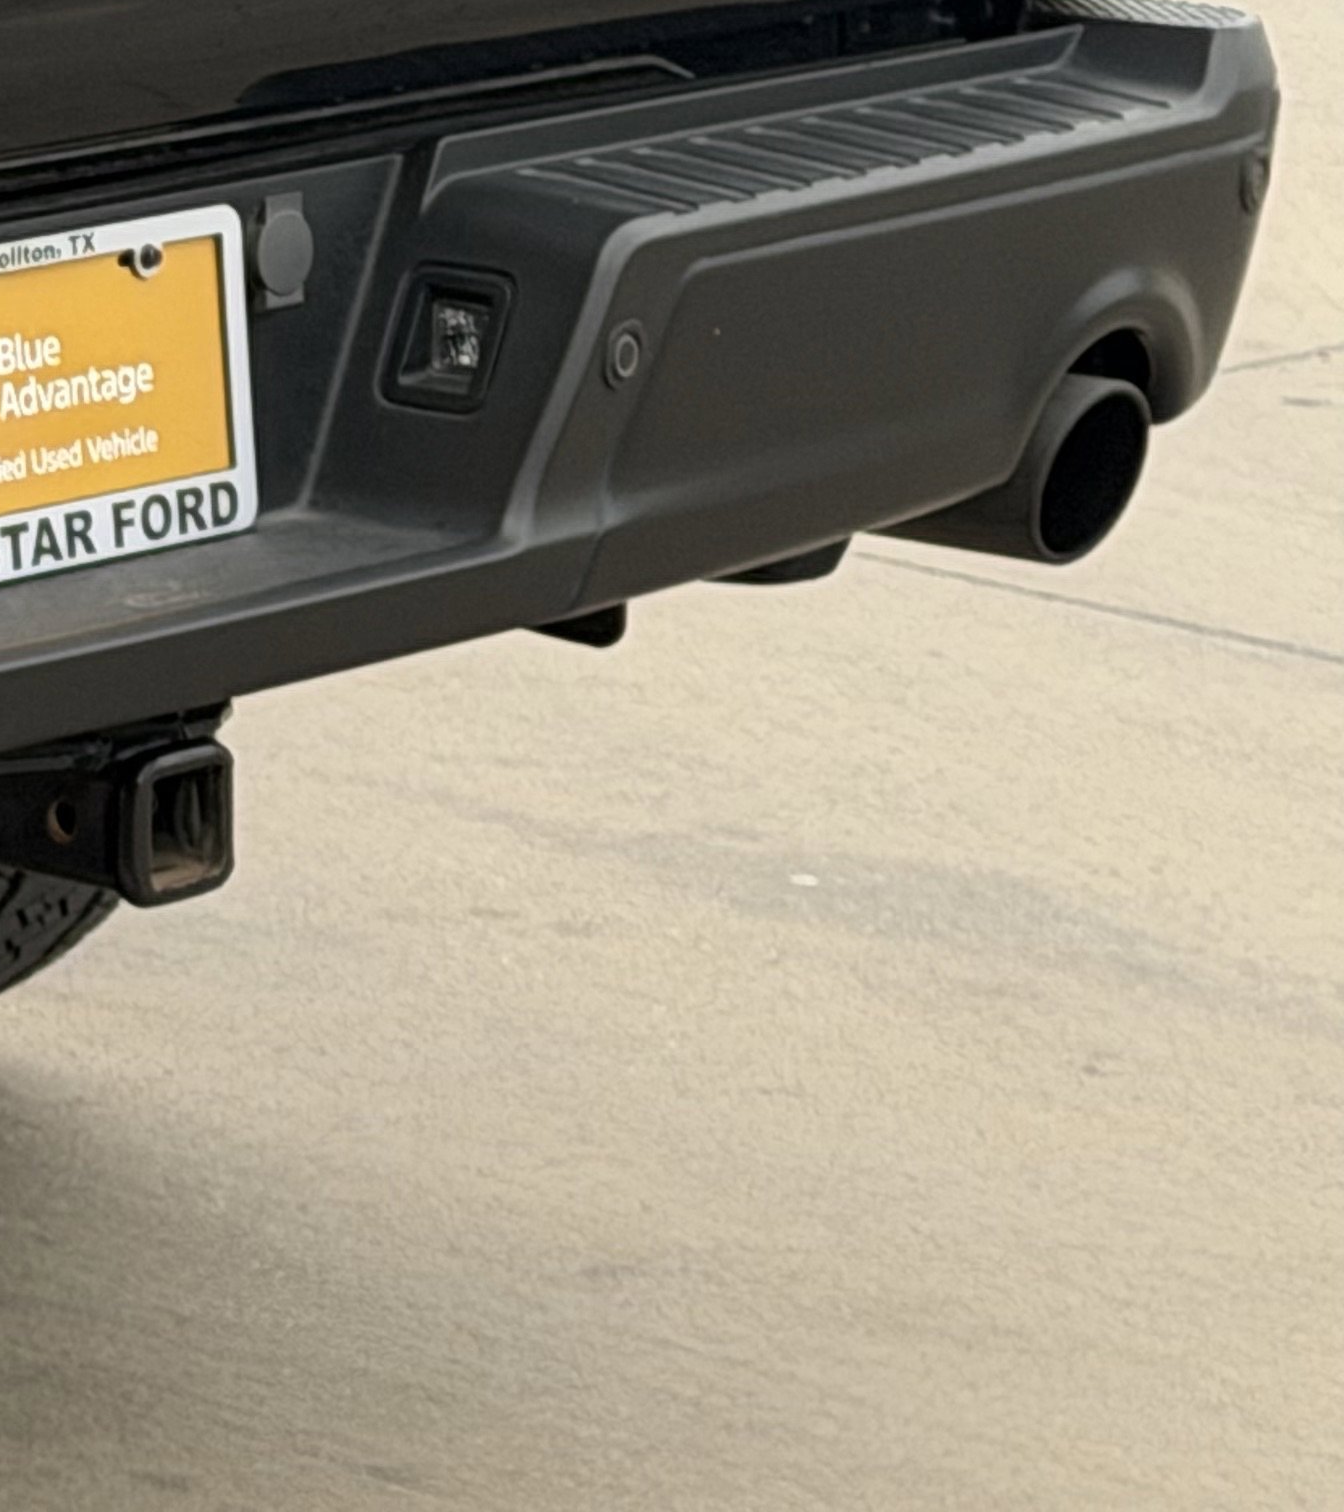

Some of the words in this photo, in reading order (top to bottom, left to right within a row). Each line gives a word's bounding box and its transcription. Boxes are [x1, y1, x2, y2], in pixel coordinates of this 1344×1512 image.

[68, 233, 97, 257] TX
[31, 441, 83, 473] Used
[88, 427, 158, 466] Vehicle
[112, 479, 241, 550] FORD
